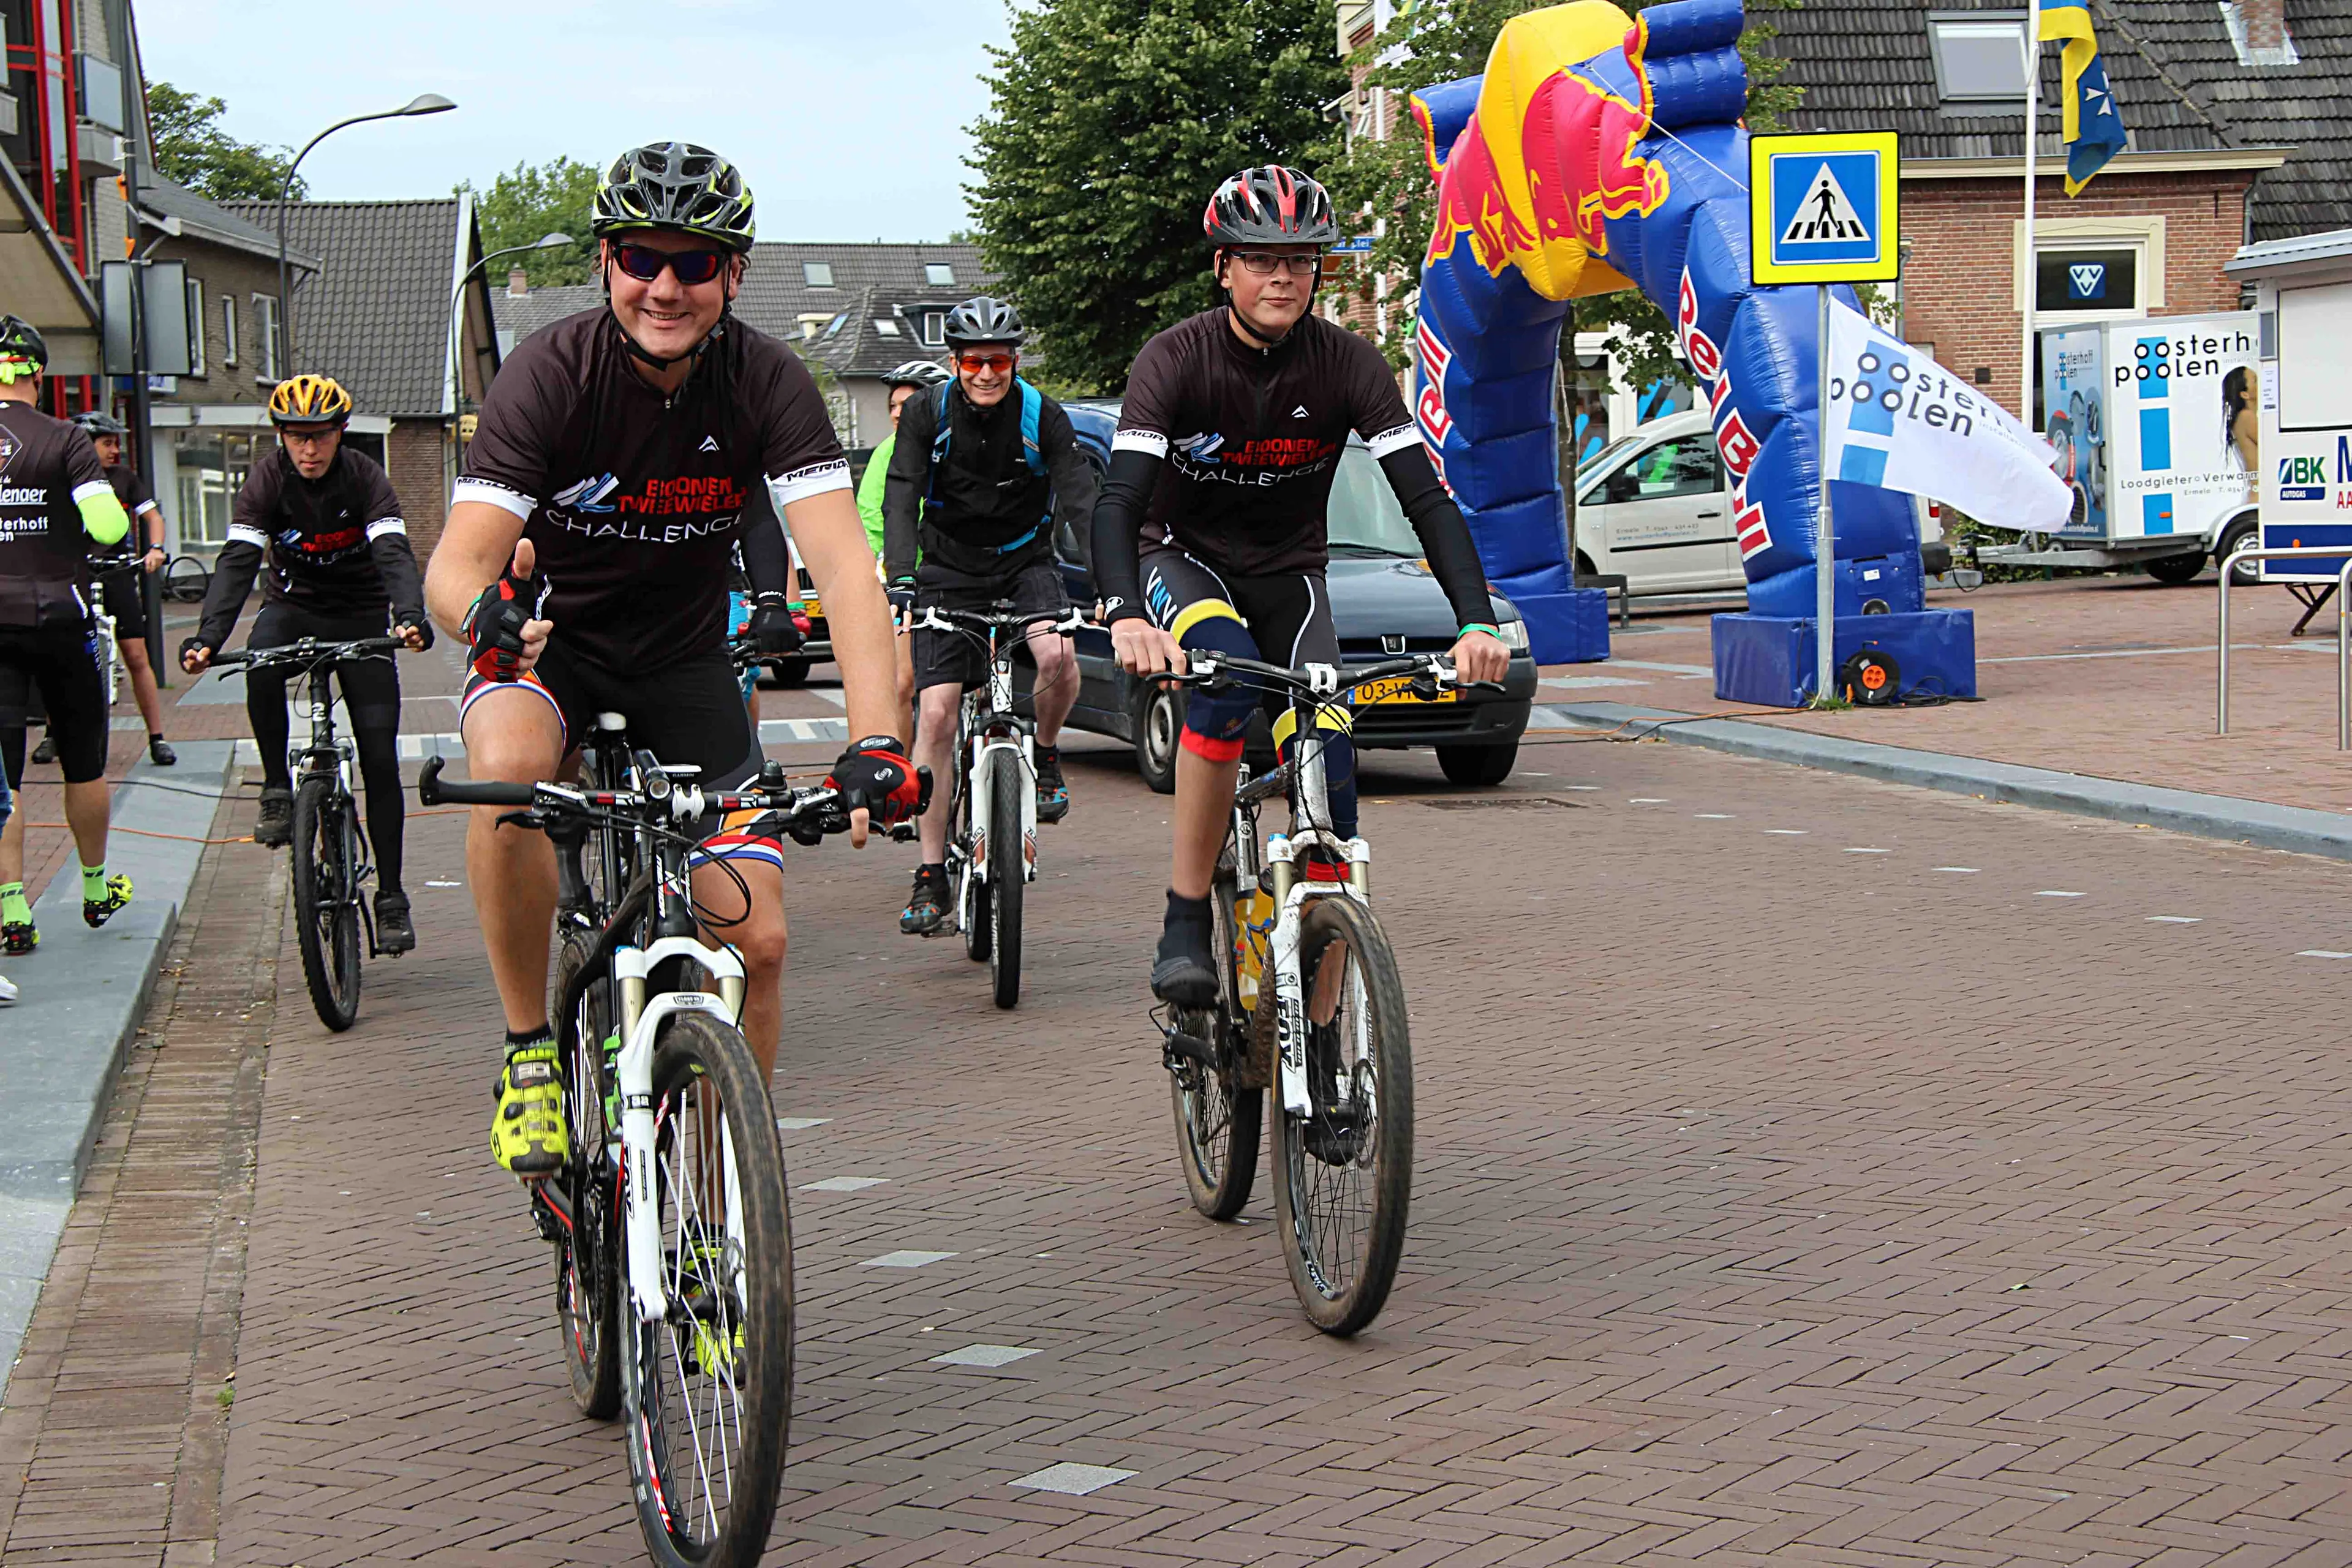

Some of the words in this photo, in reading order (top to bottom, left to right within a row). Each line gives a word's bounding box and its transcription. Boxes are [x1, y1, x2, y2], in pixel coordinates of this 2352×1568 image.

[2115, 359, 2218, 387] poolen
[1830, 377, 1973, 437] poolen
[1117, 431, 1164, 441] RIDA
[1172, 452, 1329, 486] CHALLENGE
[2121, 474, 2192, 489] Loodgieter
